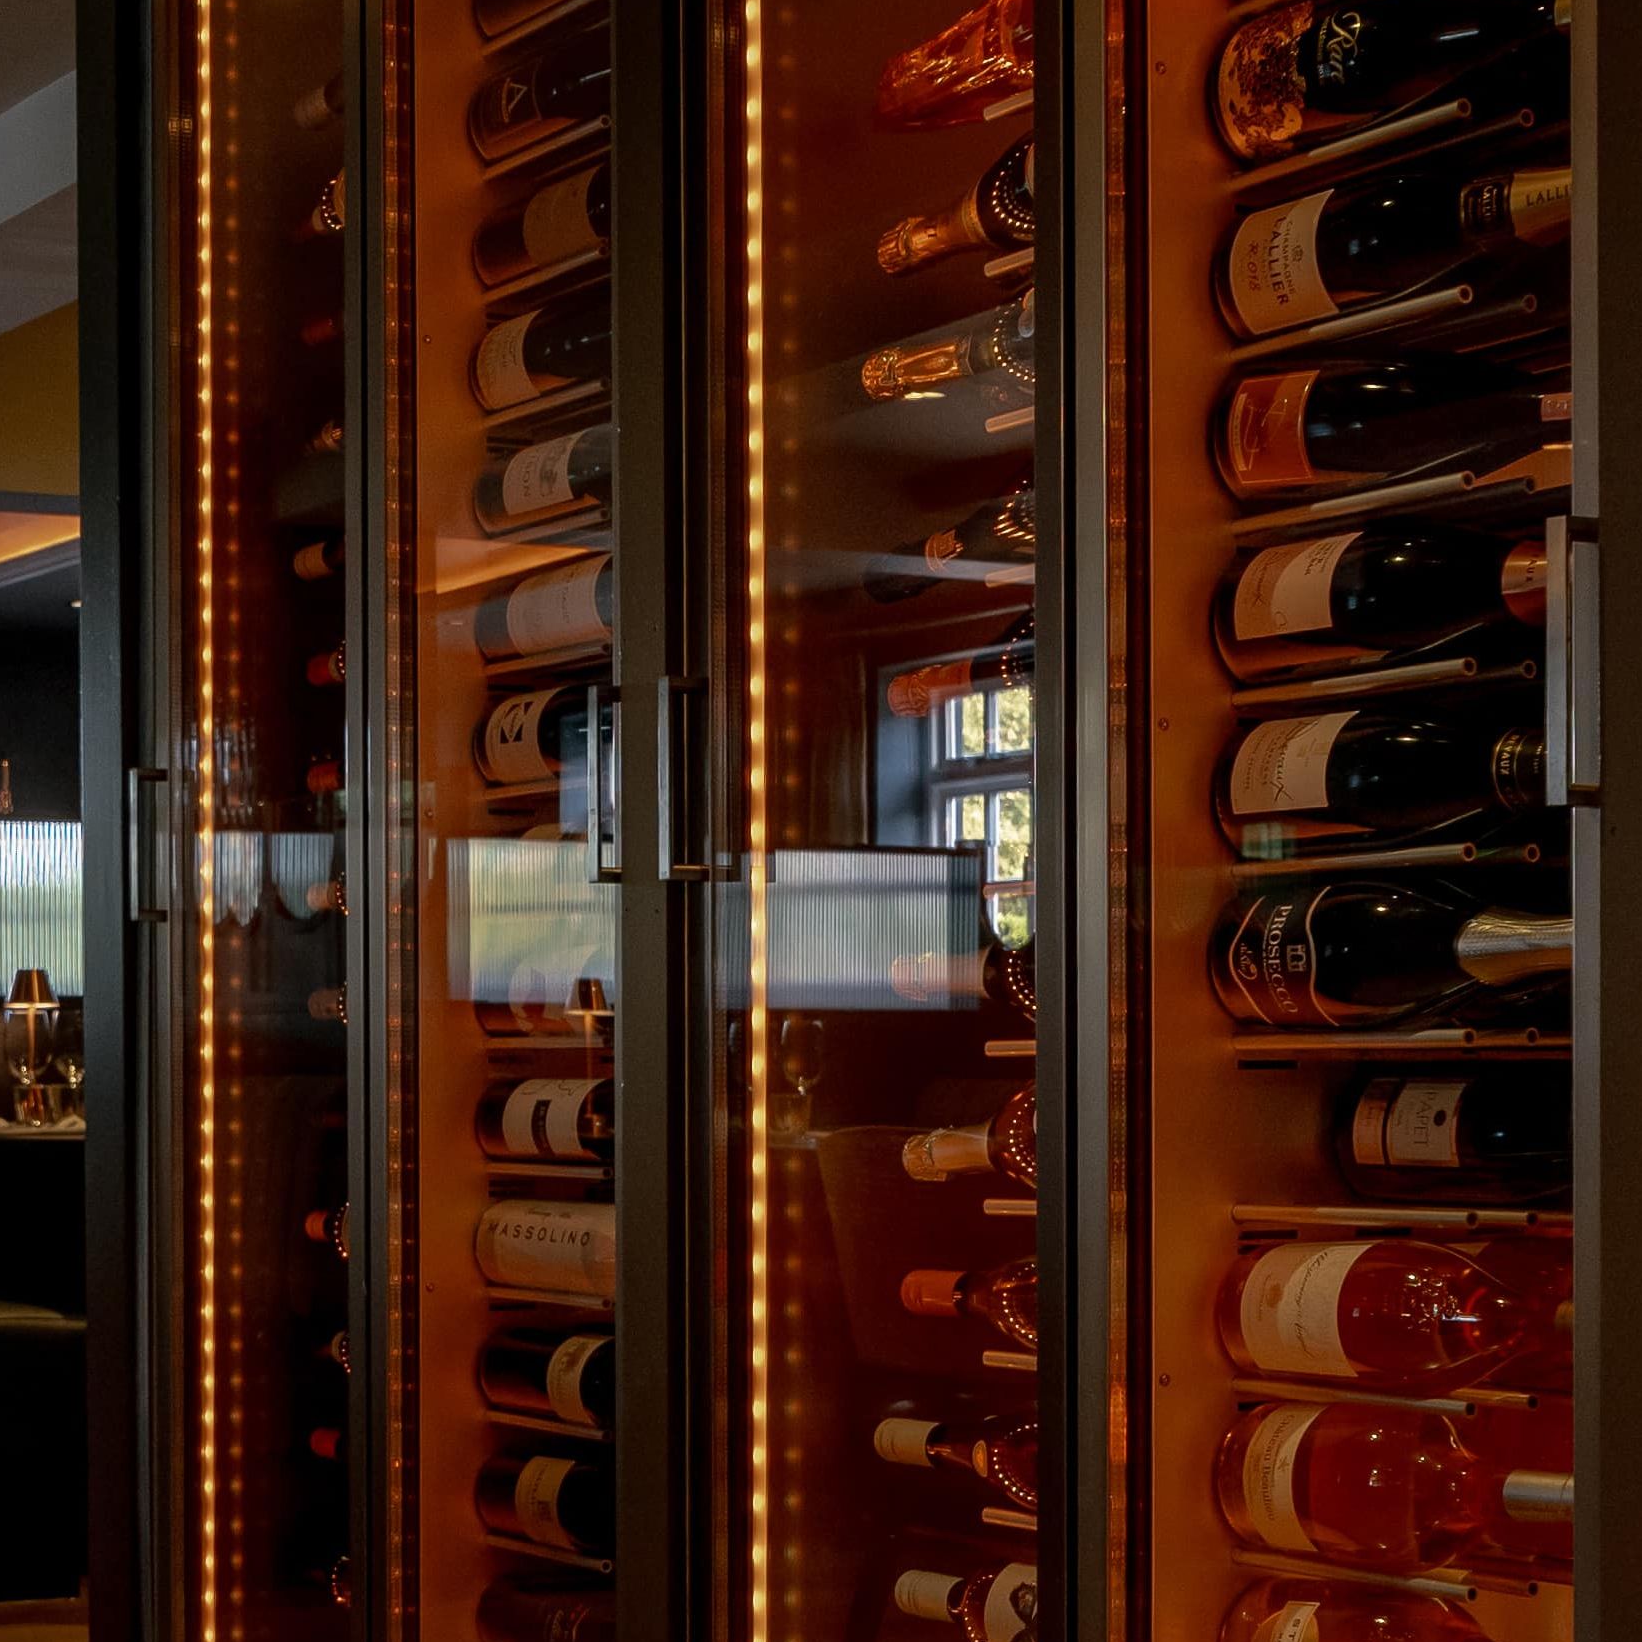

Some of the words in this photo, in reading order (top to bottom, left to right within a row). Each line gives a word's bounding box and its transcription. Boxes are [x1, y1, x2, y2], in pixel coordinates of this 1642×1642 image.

[1526, 184, 1568, 206] LALLI
[1266, 215, 1290, 304] LALLIER
[1269, 904, 1297, 1013] PROSECCO
[488, 1224, 590, 1246] MASSOLINO
